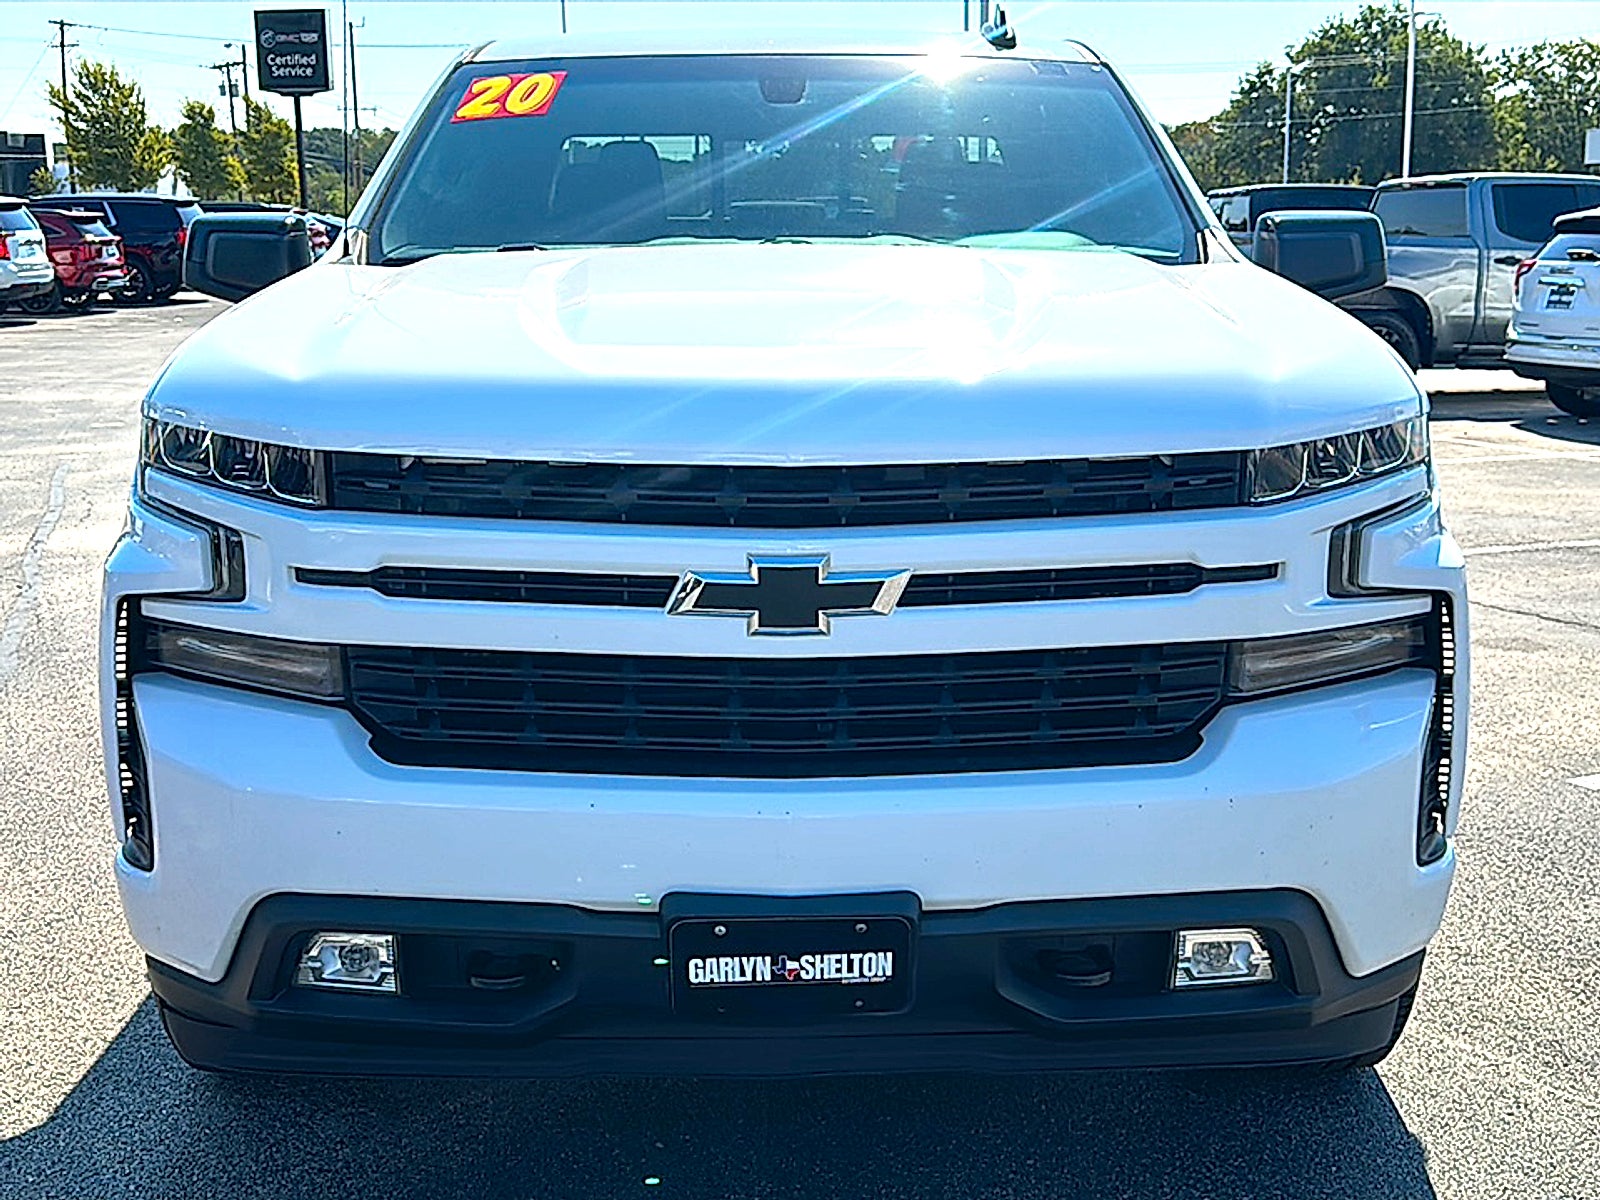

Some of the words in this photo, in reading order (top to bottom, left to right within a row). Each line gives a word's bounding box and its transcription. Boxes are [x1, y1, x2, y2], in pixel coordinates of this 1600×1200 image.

[266, 53, 317, 66] Certified
[271, 65, 314, 77] Service
[456, 73, 556, 119] 20
[688, 955, 772, 984] GARLYN
[800, 951, 893, 980] SHELTON
